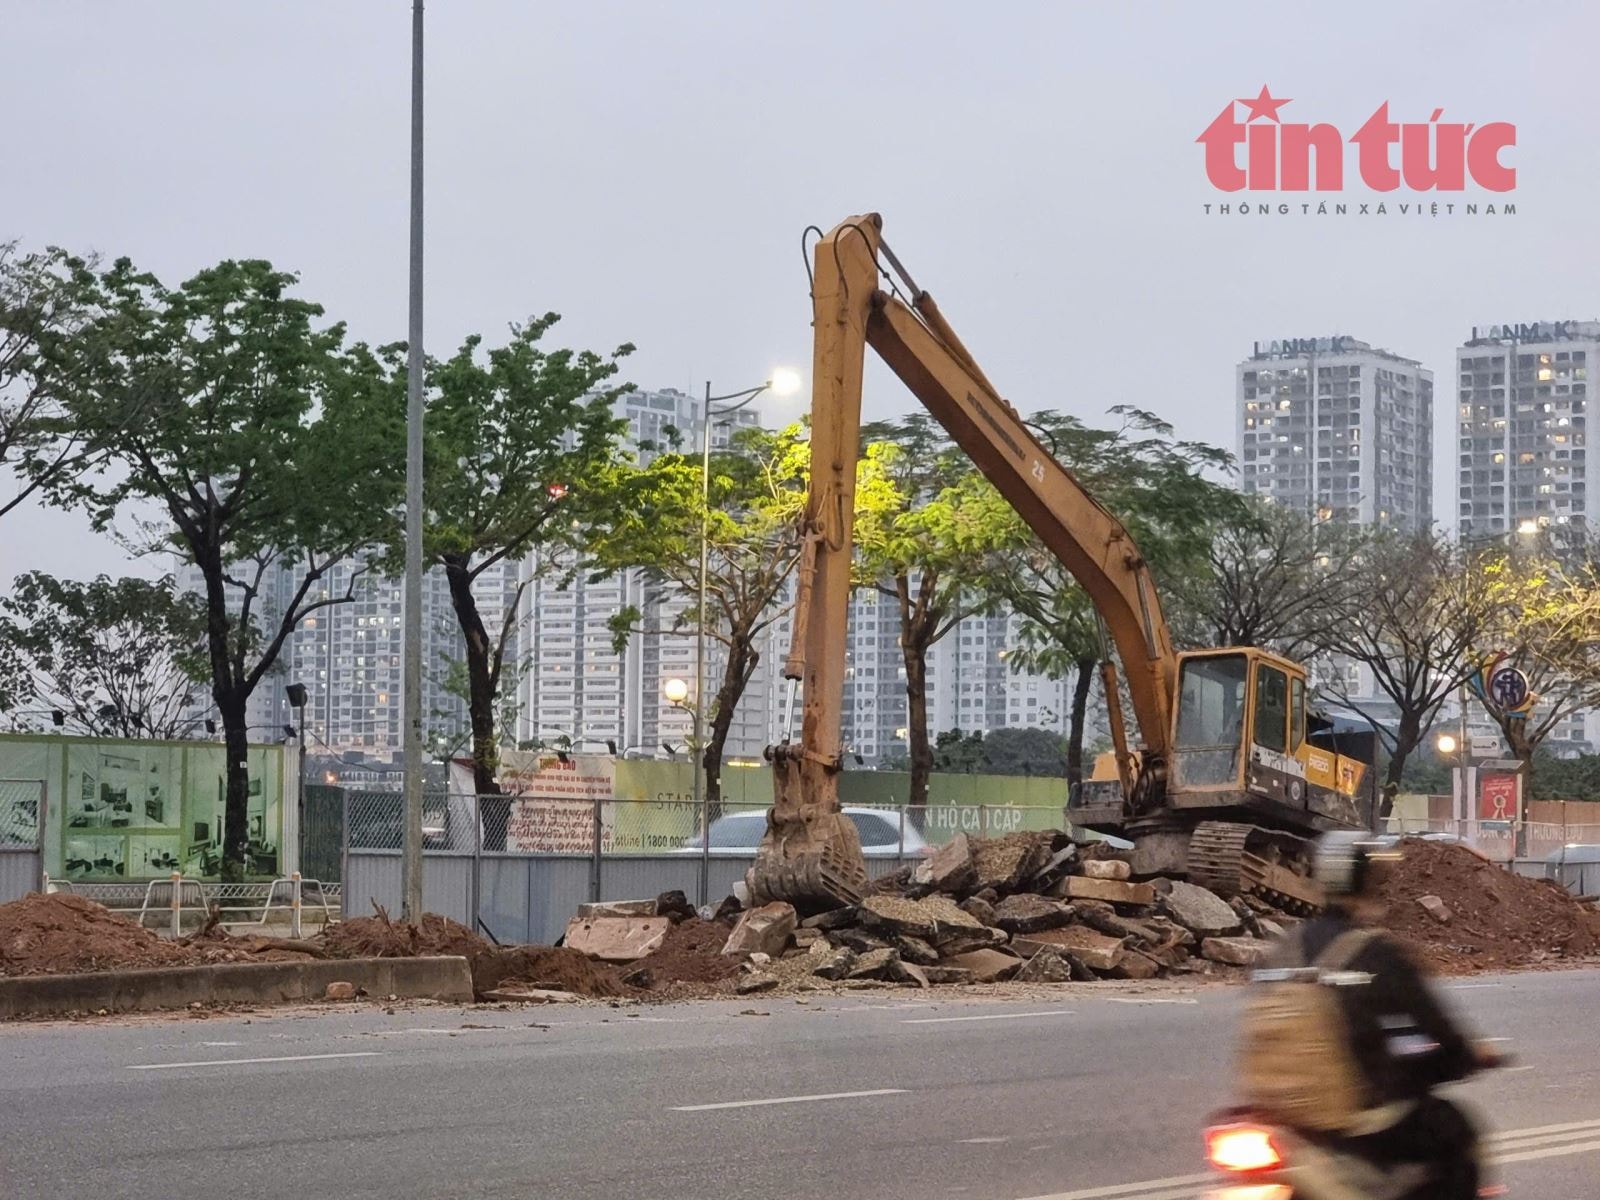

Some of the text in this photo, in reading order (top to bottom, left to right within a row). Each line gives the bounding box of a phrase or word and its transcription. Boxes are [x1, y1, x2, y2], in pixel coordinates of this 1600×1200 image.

[1471, 320, 1573, 343] LANMK
[1254, 336, 1348, 358] LANMK
[657, 792, 729, 813] STARE
